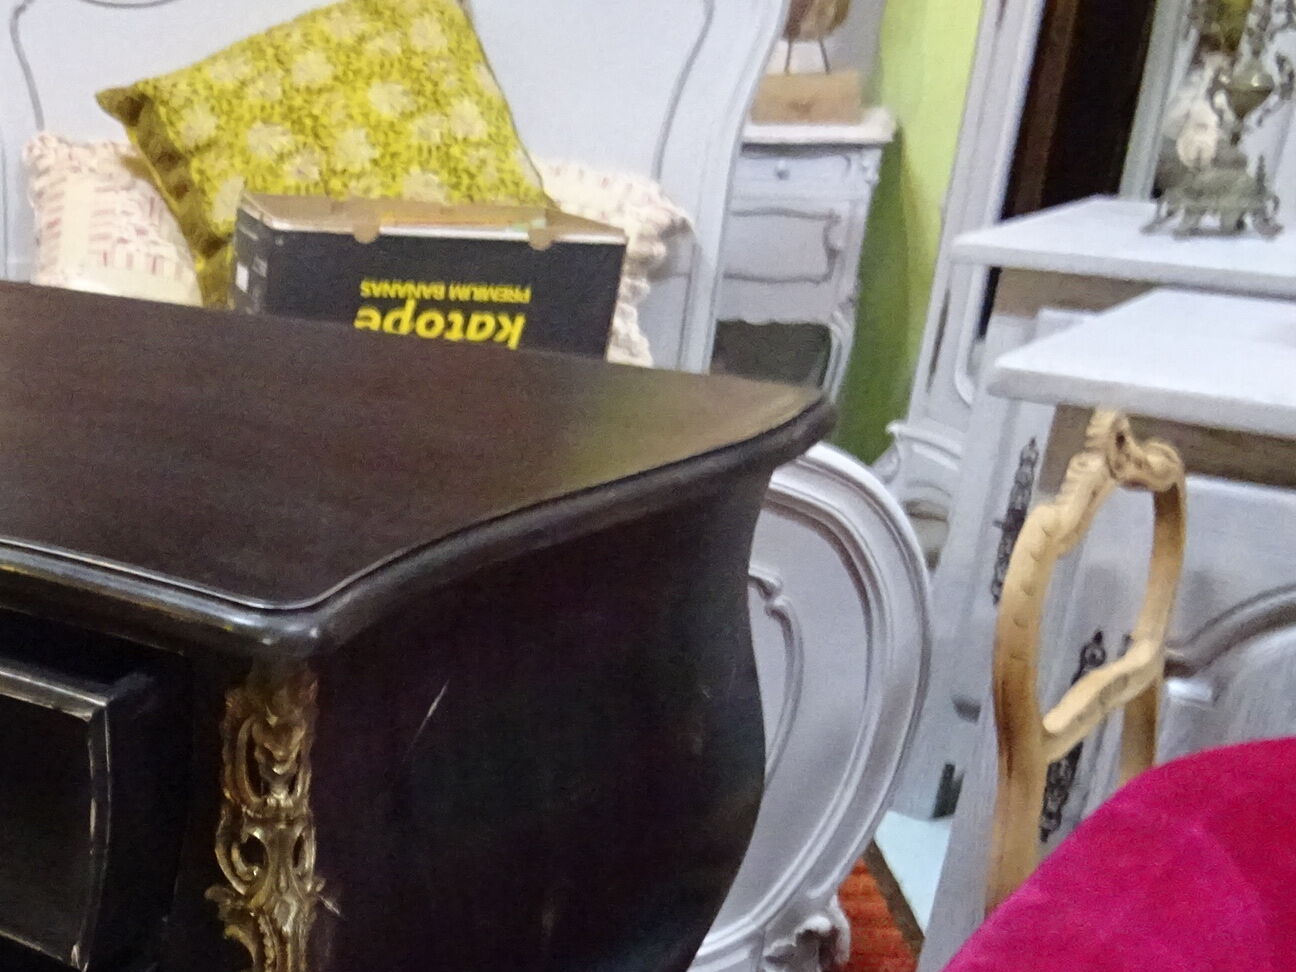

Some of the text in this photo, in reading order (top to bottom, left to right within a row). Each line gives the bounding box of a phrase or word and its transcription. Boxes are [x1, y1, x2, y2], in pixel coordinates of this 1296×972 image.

[360, 280, 531, 303] PREMIUM BANANAS
[354, 299, 526, 350] katope
